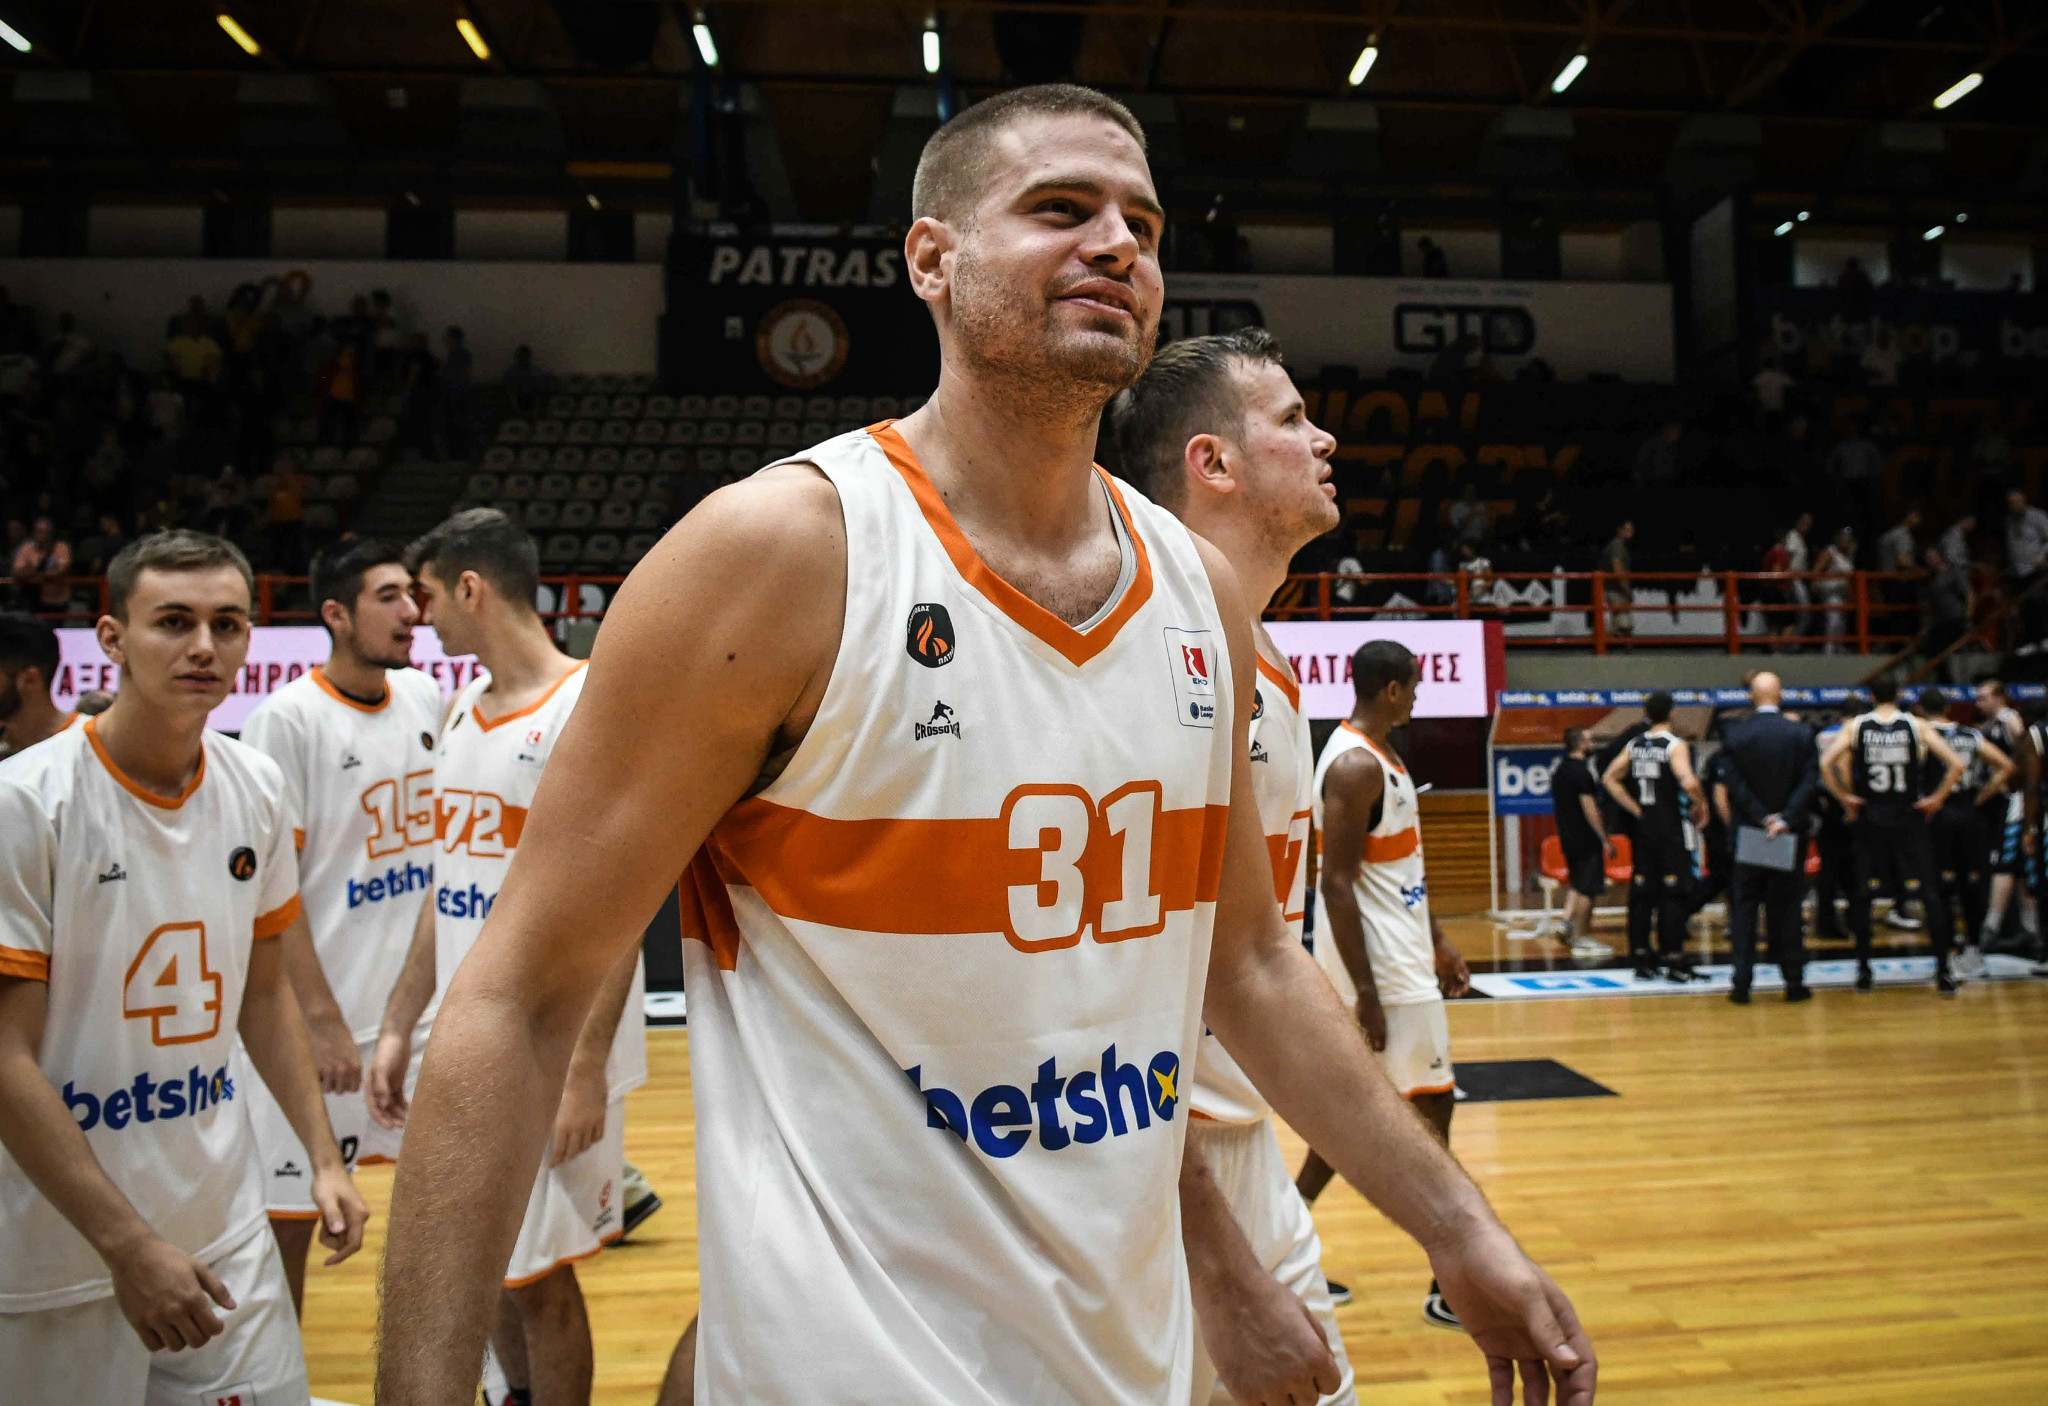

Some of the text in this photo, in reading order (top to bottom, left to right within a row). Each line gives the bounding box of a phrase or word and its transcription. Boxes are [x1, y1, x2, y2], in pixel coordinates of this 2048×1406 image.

[707, 245, 899, 288] PATRAS
[361, 768, 434, 860] 15
[1867, 764, 1908, 793] 31
[440, 788, 505, 859] 72
[1000, 780, 1165, 953] 31
[123, 920, 222, 1046] 4
